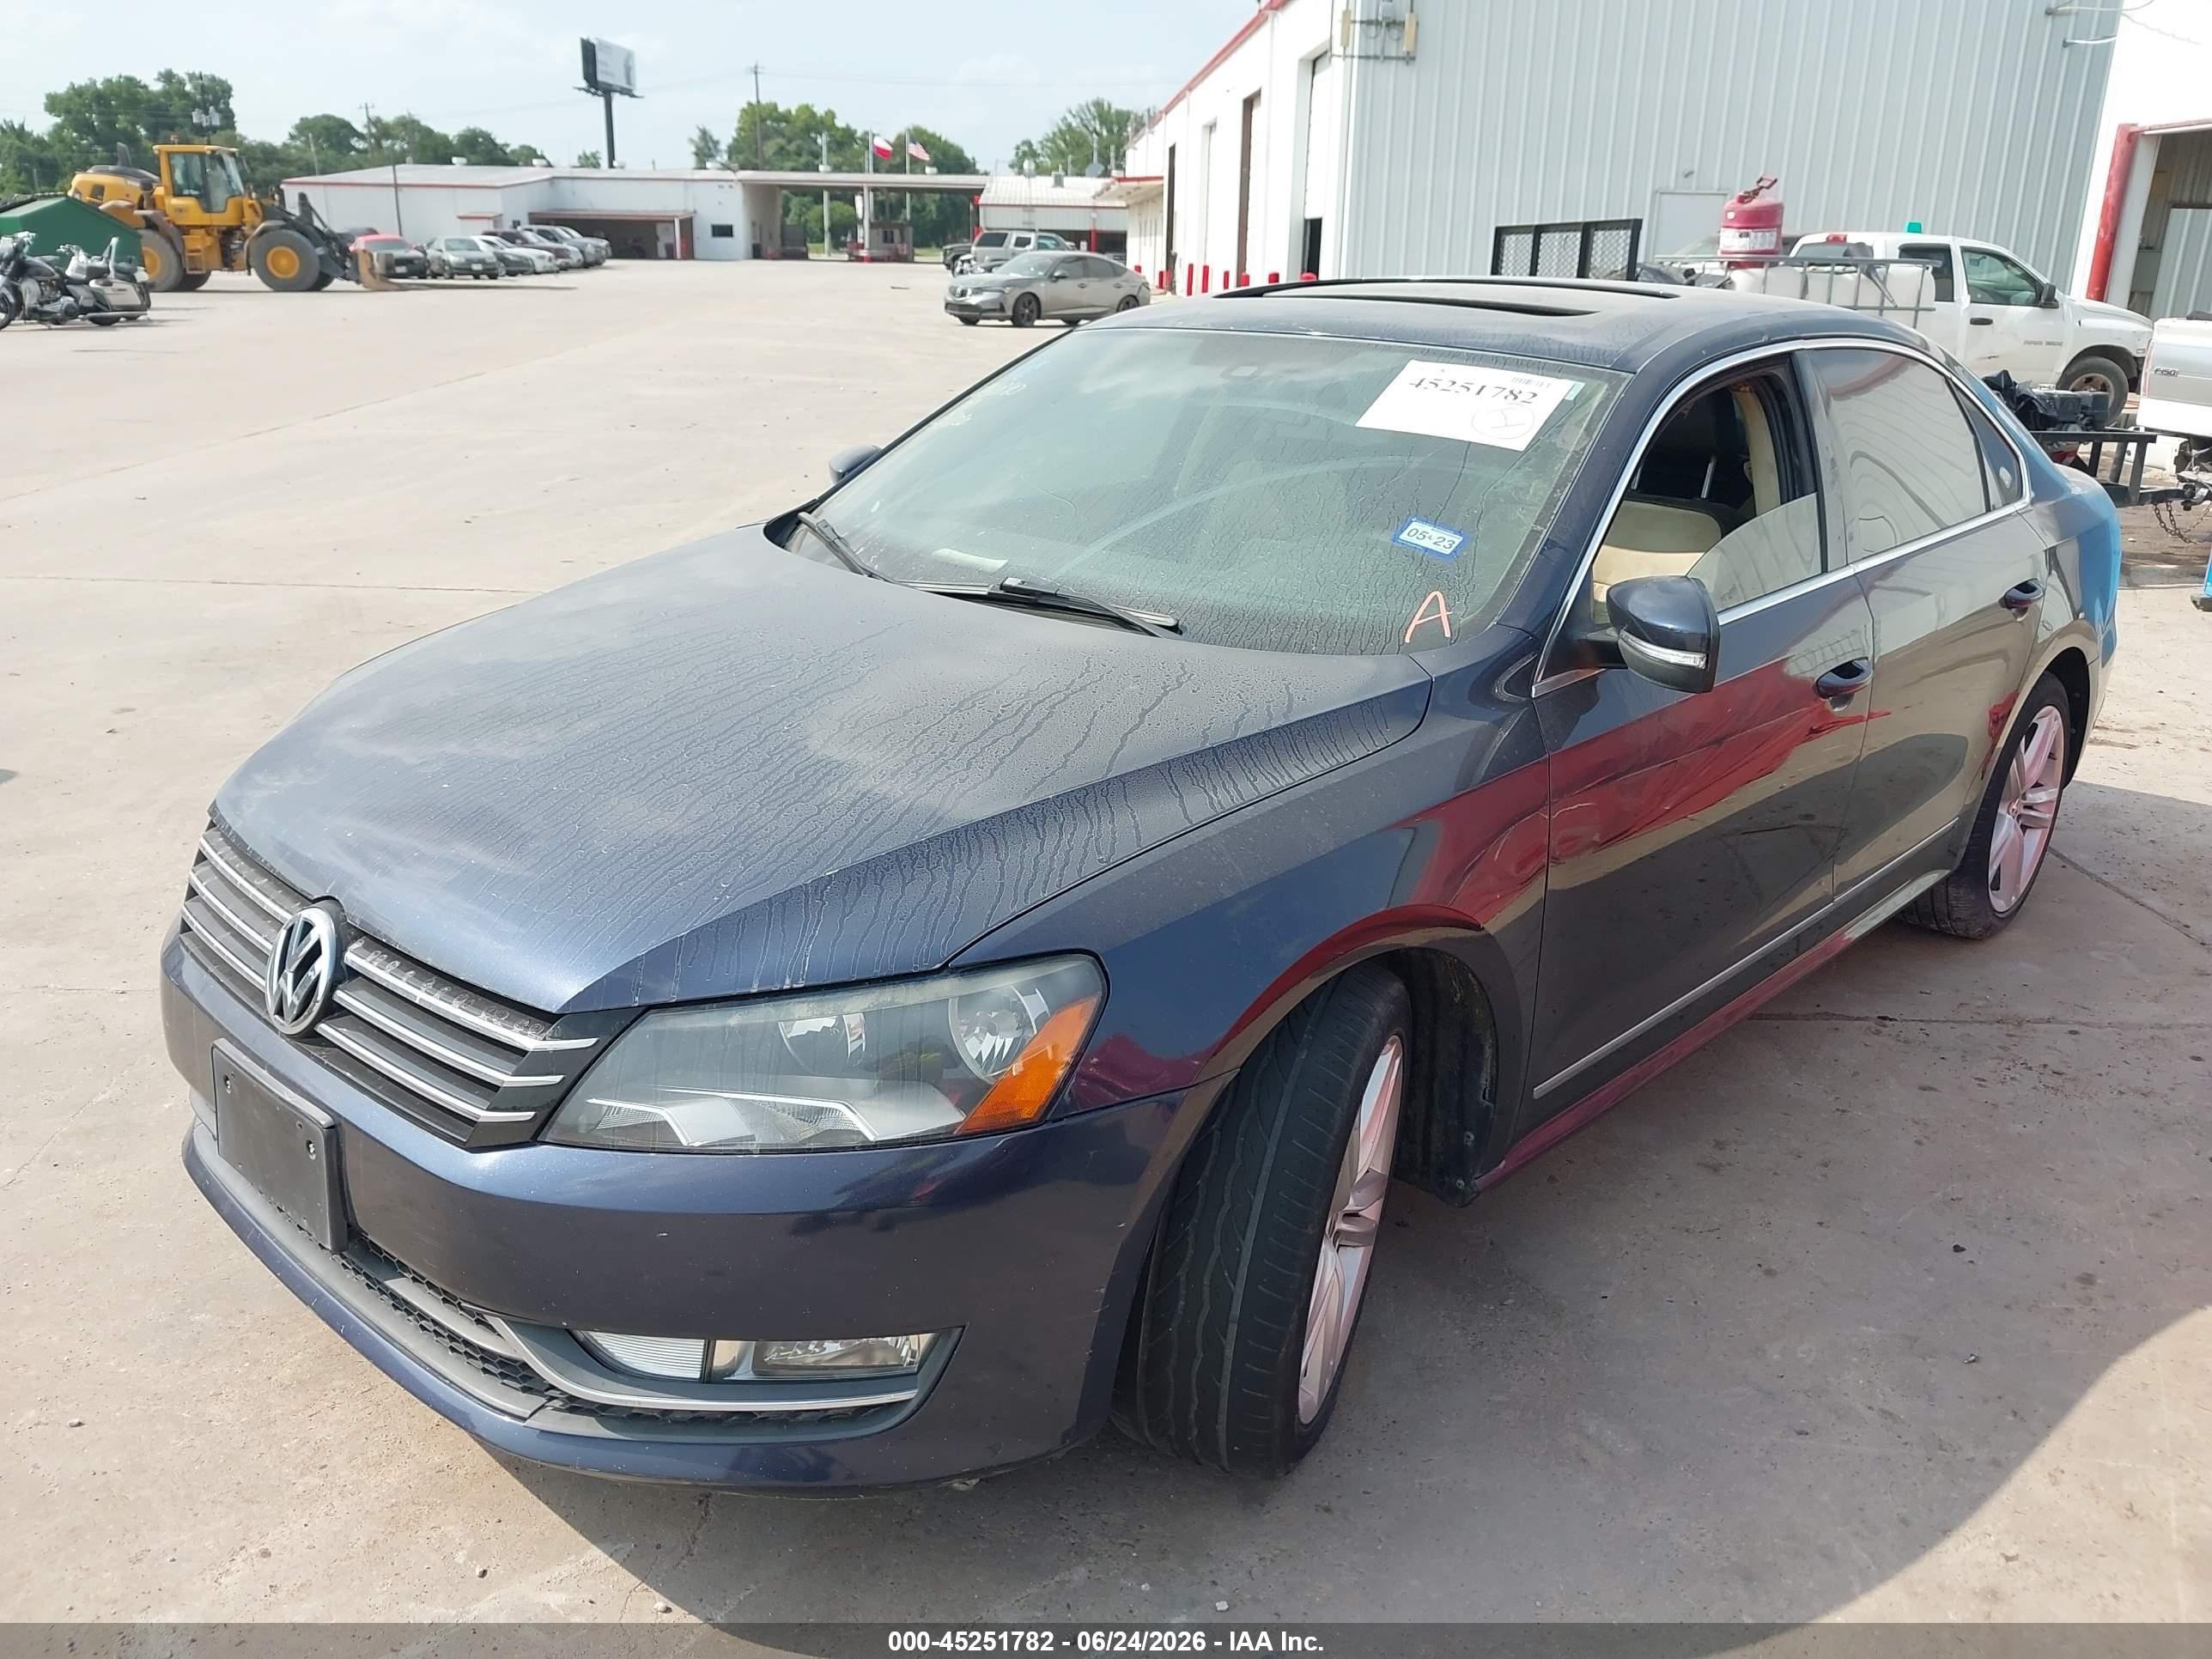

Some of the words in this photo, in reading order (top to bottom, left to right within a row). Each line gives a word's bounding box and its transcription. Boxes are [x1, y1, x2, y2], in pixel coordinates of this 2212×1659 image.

[1409, 377, 1539, 404] 45251782
[1407, 527, 1430, 541] 05
[1432, 536, 1456, 550] 23
[1405, 590, 1453, 643] A
